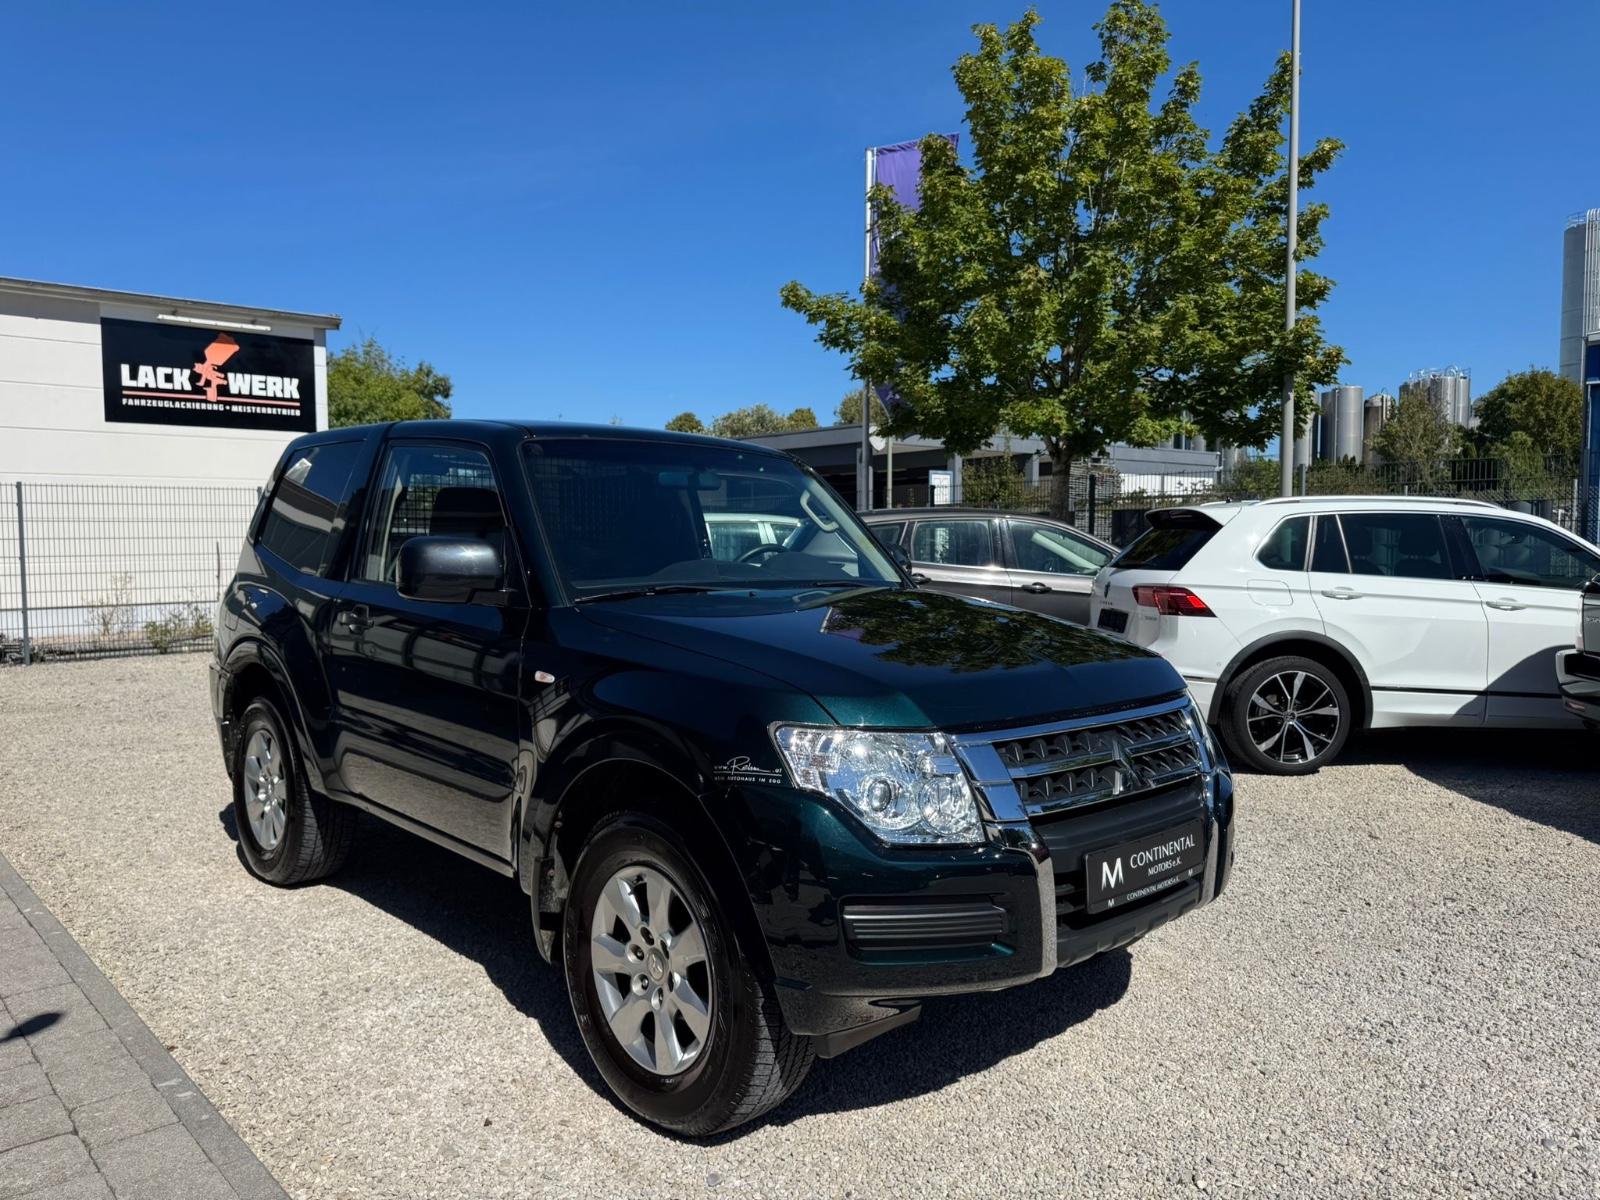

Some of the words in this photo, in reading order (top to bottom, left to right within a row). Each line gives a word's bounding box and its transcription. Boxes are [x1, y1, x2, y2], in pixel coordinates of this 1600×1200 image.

[120, 363, 192, 391] LACK
[227, 372, 300, 399] WERK
[122, 398, 224, 412] FAHRZEUGLACKIERUNG
[1130, 834, 1196, 869] CONTINENTAL
[1148, 860, 1172, 876] MOTORS
[1101, 857, 1124, 891] M
